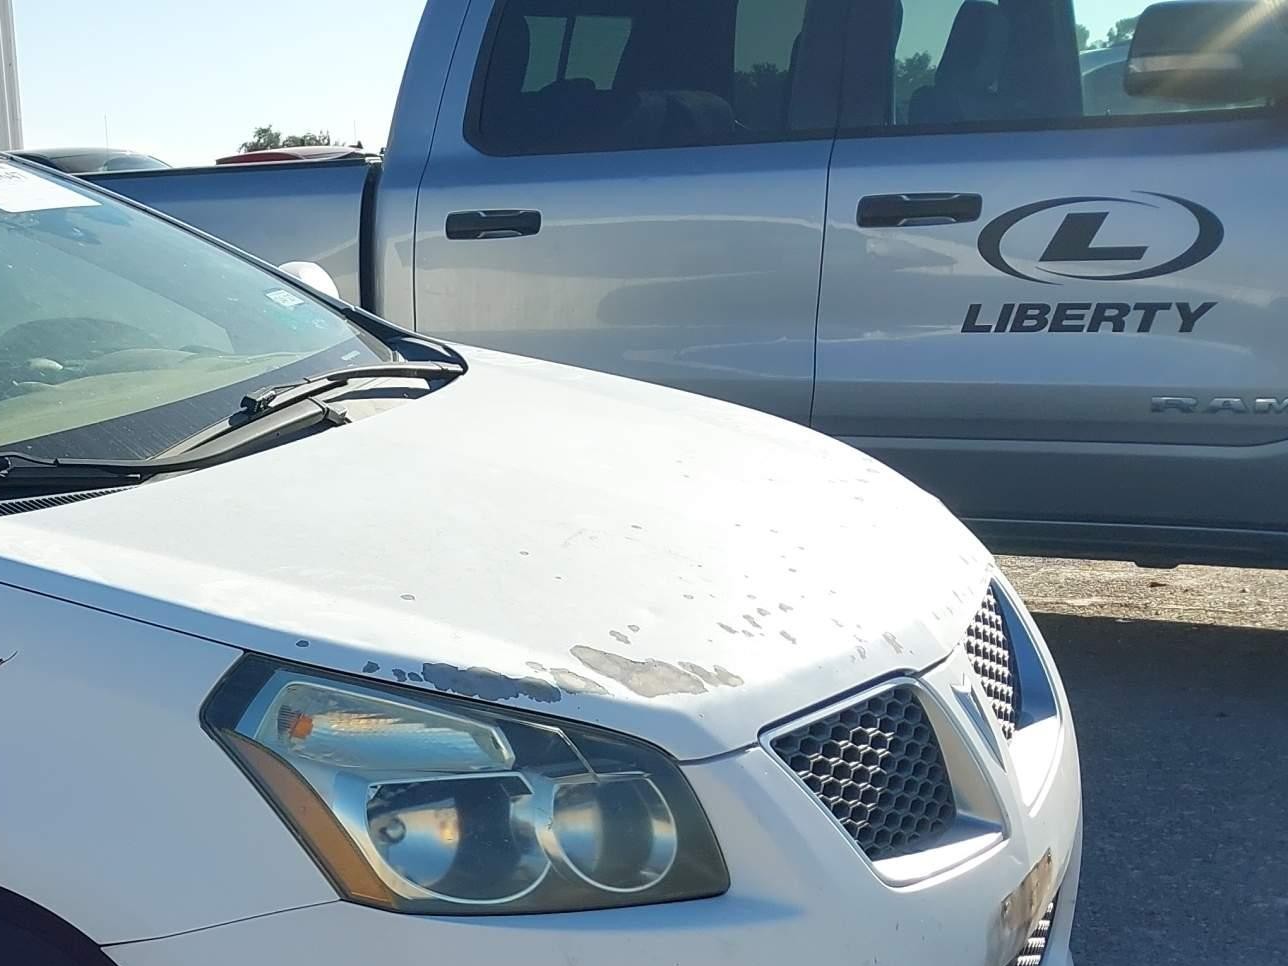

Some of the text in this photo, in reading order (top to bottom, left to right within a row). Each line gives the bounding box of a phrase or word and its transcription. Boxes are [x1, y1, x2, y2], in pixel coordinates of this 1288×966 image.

[1039, 212, 1149, 262] L
[961, 302, 1219, 333] LIBERTY
[1151, 396, 1288, 415] RAM
